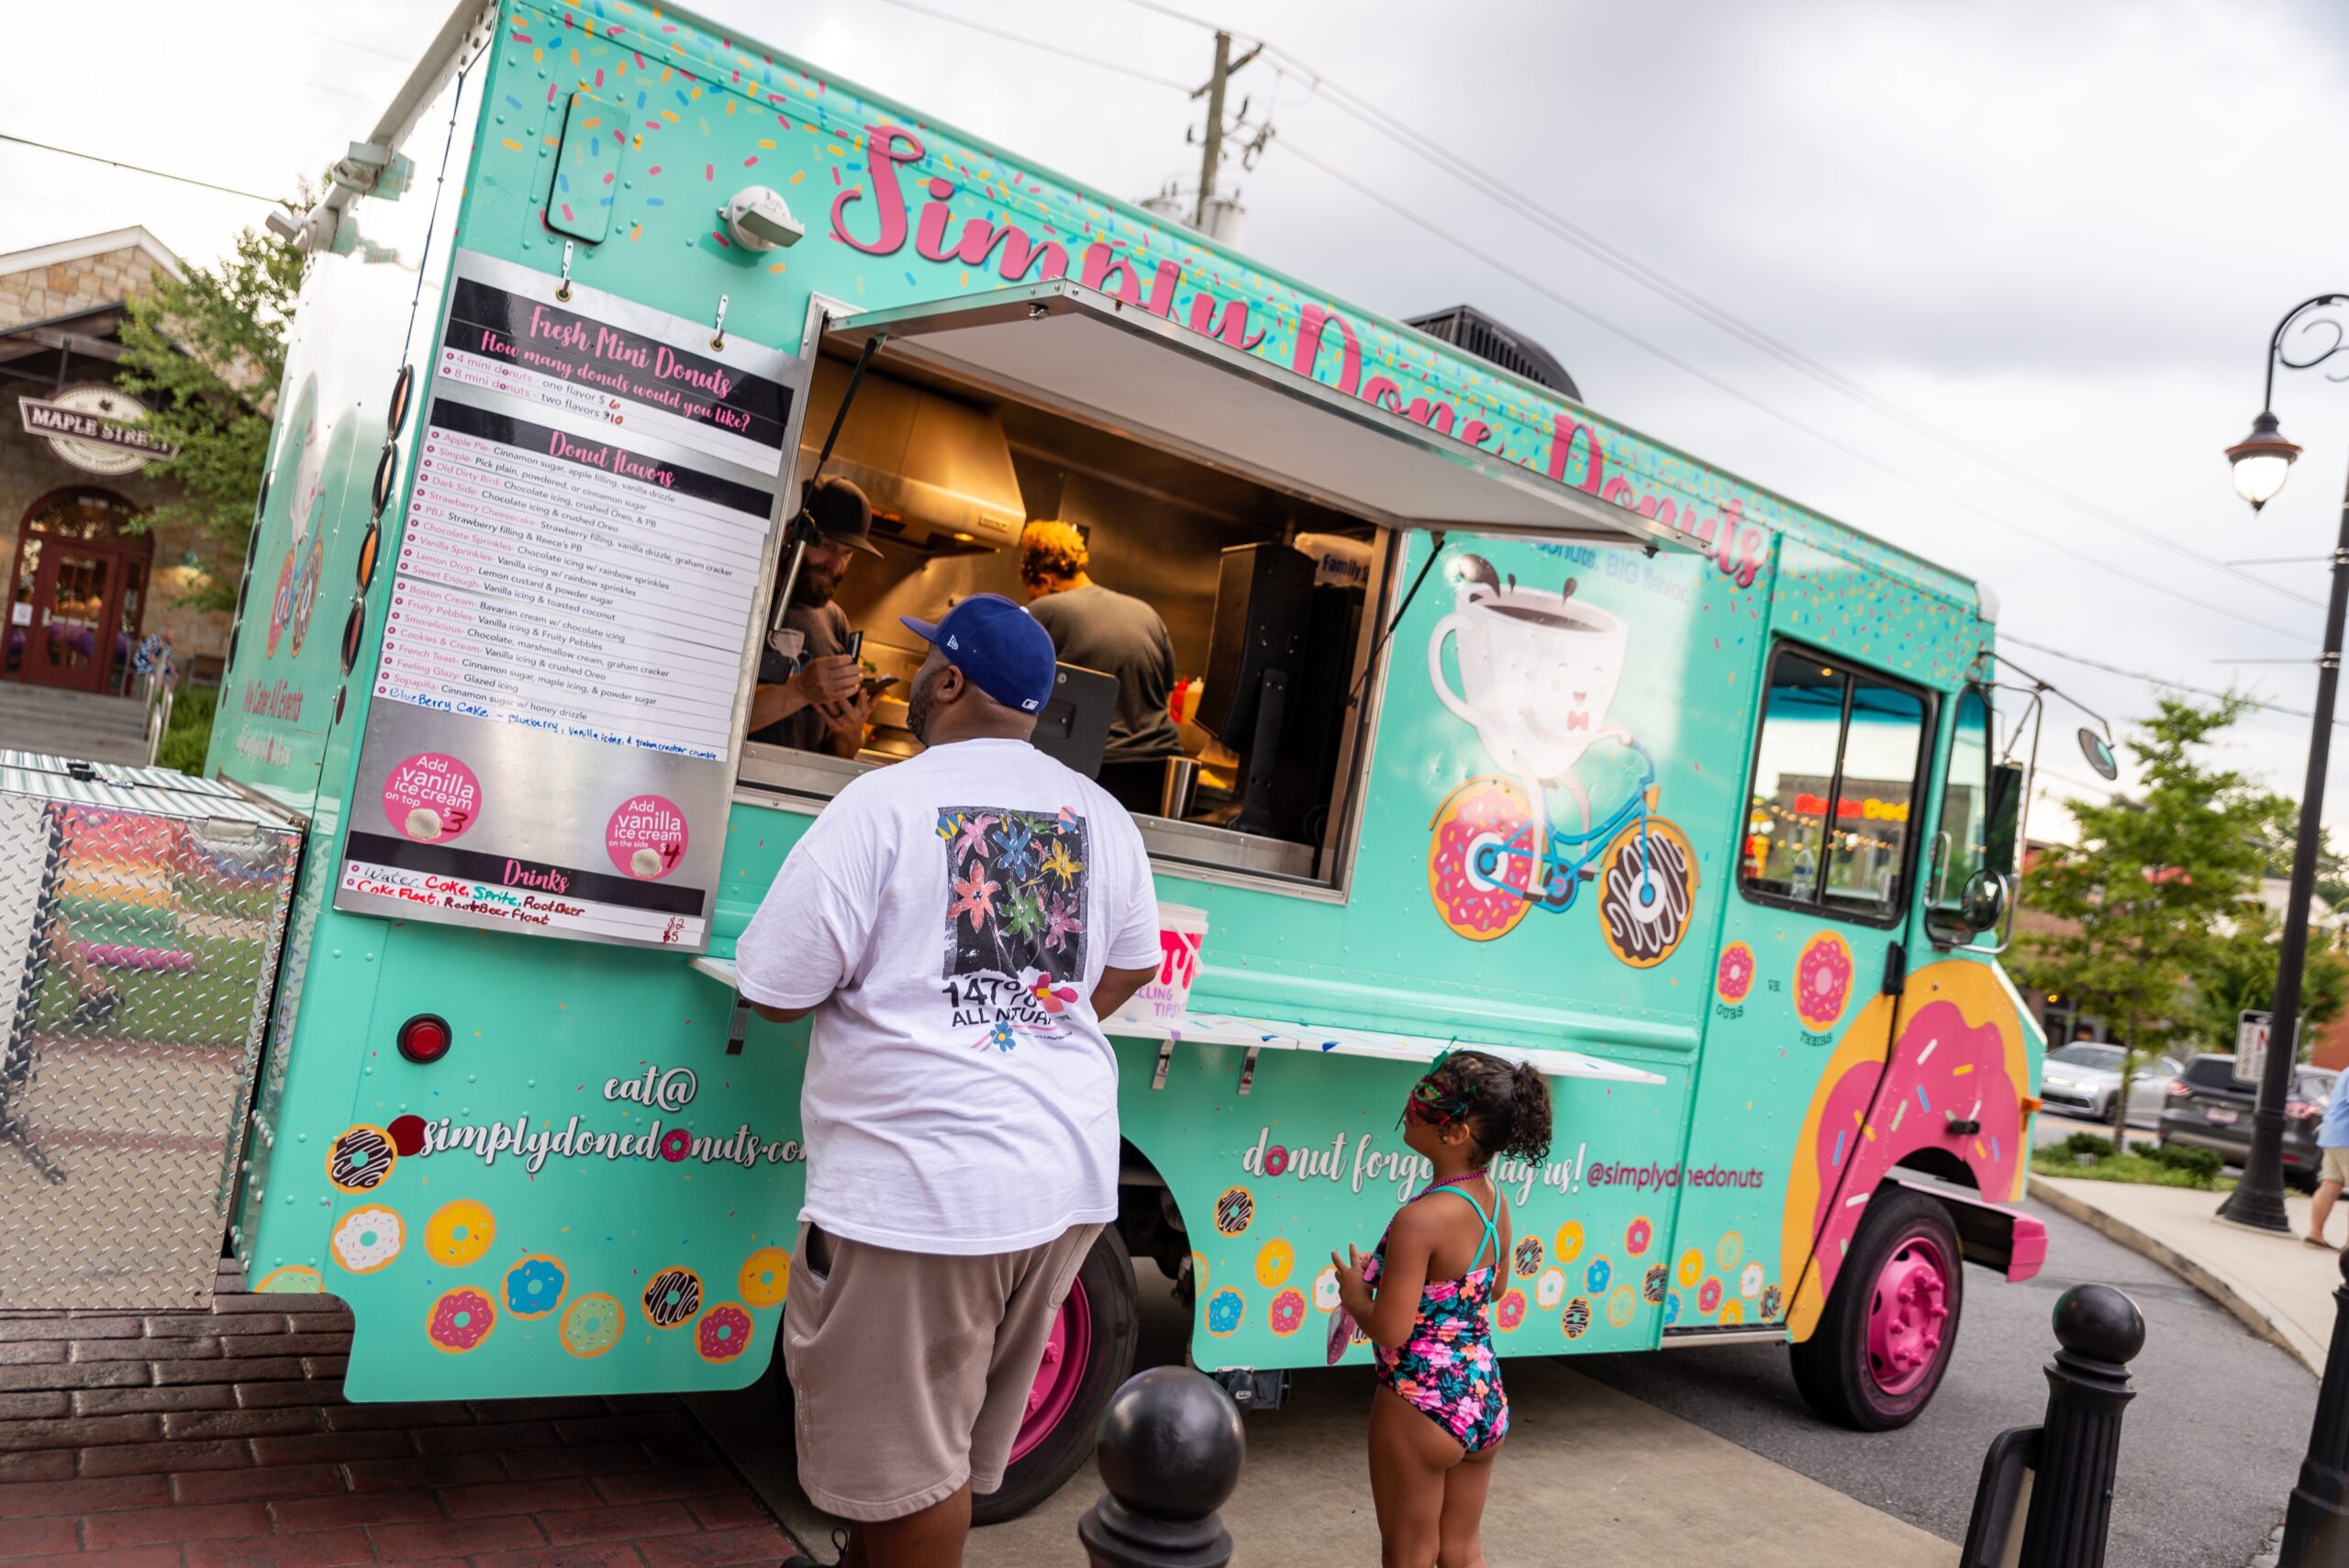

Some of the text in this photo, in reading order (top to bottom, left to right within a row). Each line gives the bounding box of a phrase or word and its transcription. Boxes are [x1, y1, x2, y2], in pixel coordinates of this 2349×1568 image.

[529, 306, 732, 399] Fresh Mini Donuts
[454, 368, 462, 378] 8
[465, 373, 489, 386] mini
[492, 377, 530, 397] donuts
[541, 394, 562, 406] two
[564, 399, 599, 417] flavors
[457, 354, 464, 363] 4
[467, 358, 491, 373] mini
[495, 362, 533, 383] donuts
[542, 381, 563, 393] one
[566, 384, 595, 402] flavor
[481, 329, 751, 432] How many donuts would you like?
[31, 406, 169, 451] MAPLE STRET
[494, 447, 538, 464] Cinnamon
[569, 470, 592, 479] apple
[622, 484, 647, 495] vanilla
[650, 490, 674, 502] drizzle
[549, 430, 675, 488] Donut flavors
[475, 457, 646, 510] Pick cinnamon sugar
[482, 491, 618, 532] Chocolate icing crushed Oreo
[505, 481, 656, 528] Chocolate crushed PB
[449, 513, 582, 551] Strawberry filling Reece's PB
[541, 521, 587, 540] Strawberry
[618, 542, 642, 553] vanilla
[675, 558, 704, 569] graham
[707, 566, 732, 576] cracker
[498, 556, 525, 569] Vanilla
[529, 564, 549, 576] icing
[564, 574, 598, 587] rainbow
[600, 584, 636, 596] sprinkles
[518, 547, 562, 562] Chocolate
[564, 558, 584, 570] icing
[599, 568, 632, 580] rainbow
[635, 577, 669, 589] sprinkles
[1322, 553, 1361, 581] Family
[1607, 551, 1638, 585] BIG
[479, 567, 613, 605] Lemon custard powder sugar
[484, 583, 615, 620] Vanilla icing toasted coconut
[479, 616, 507, 628] Vanilla
[509, 624, 529, 635] icing
[542, 630, 566, 643] Fruity
[569, 637, 602, 651] Pebbles
[480, 602, 625, 643] Bavarian cream chocolate icing
[485, 648, 513, 660] Vanilla
[517, 654, 536, 666] icing
[549, 663, 582, 675] crushed
[584, 670, 606, 680] Oreo
[518, 641, 668, 677] marshmallow graham cracker
[462, 659, 657, 706] Cinnamon maple powder sugar
[464, 674, 495, 686] Glazed
[497, 681, 518, 693] icing
[441, 684, 586, 719] Cinnamon honey drizzle
[417, 755, 448, 773] Add
[385, 791, 420, 808] on top
[394, 776, 473, 810] ice cream
[402, 767, 474, 799] vanilla
[618, 811, 681, 830] vanilla
[628, 800, 655, 813] Add
[615, 825, 682, 841] ice cream
[619, 840, 632, 848] the
[504, 859, 570, 895] Drinks
[952, 1007, 990, 1027] ALL
[1242, 1126, 1348, 1181] donut
[1352, 1133, 1434, 1203] forge
[1543, 1142, 1586, 1195] us!
